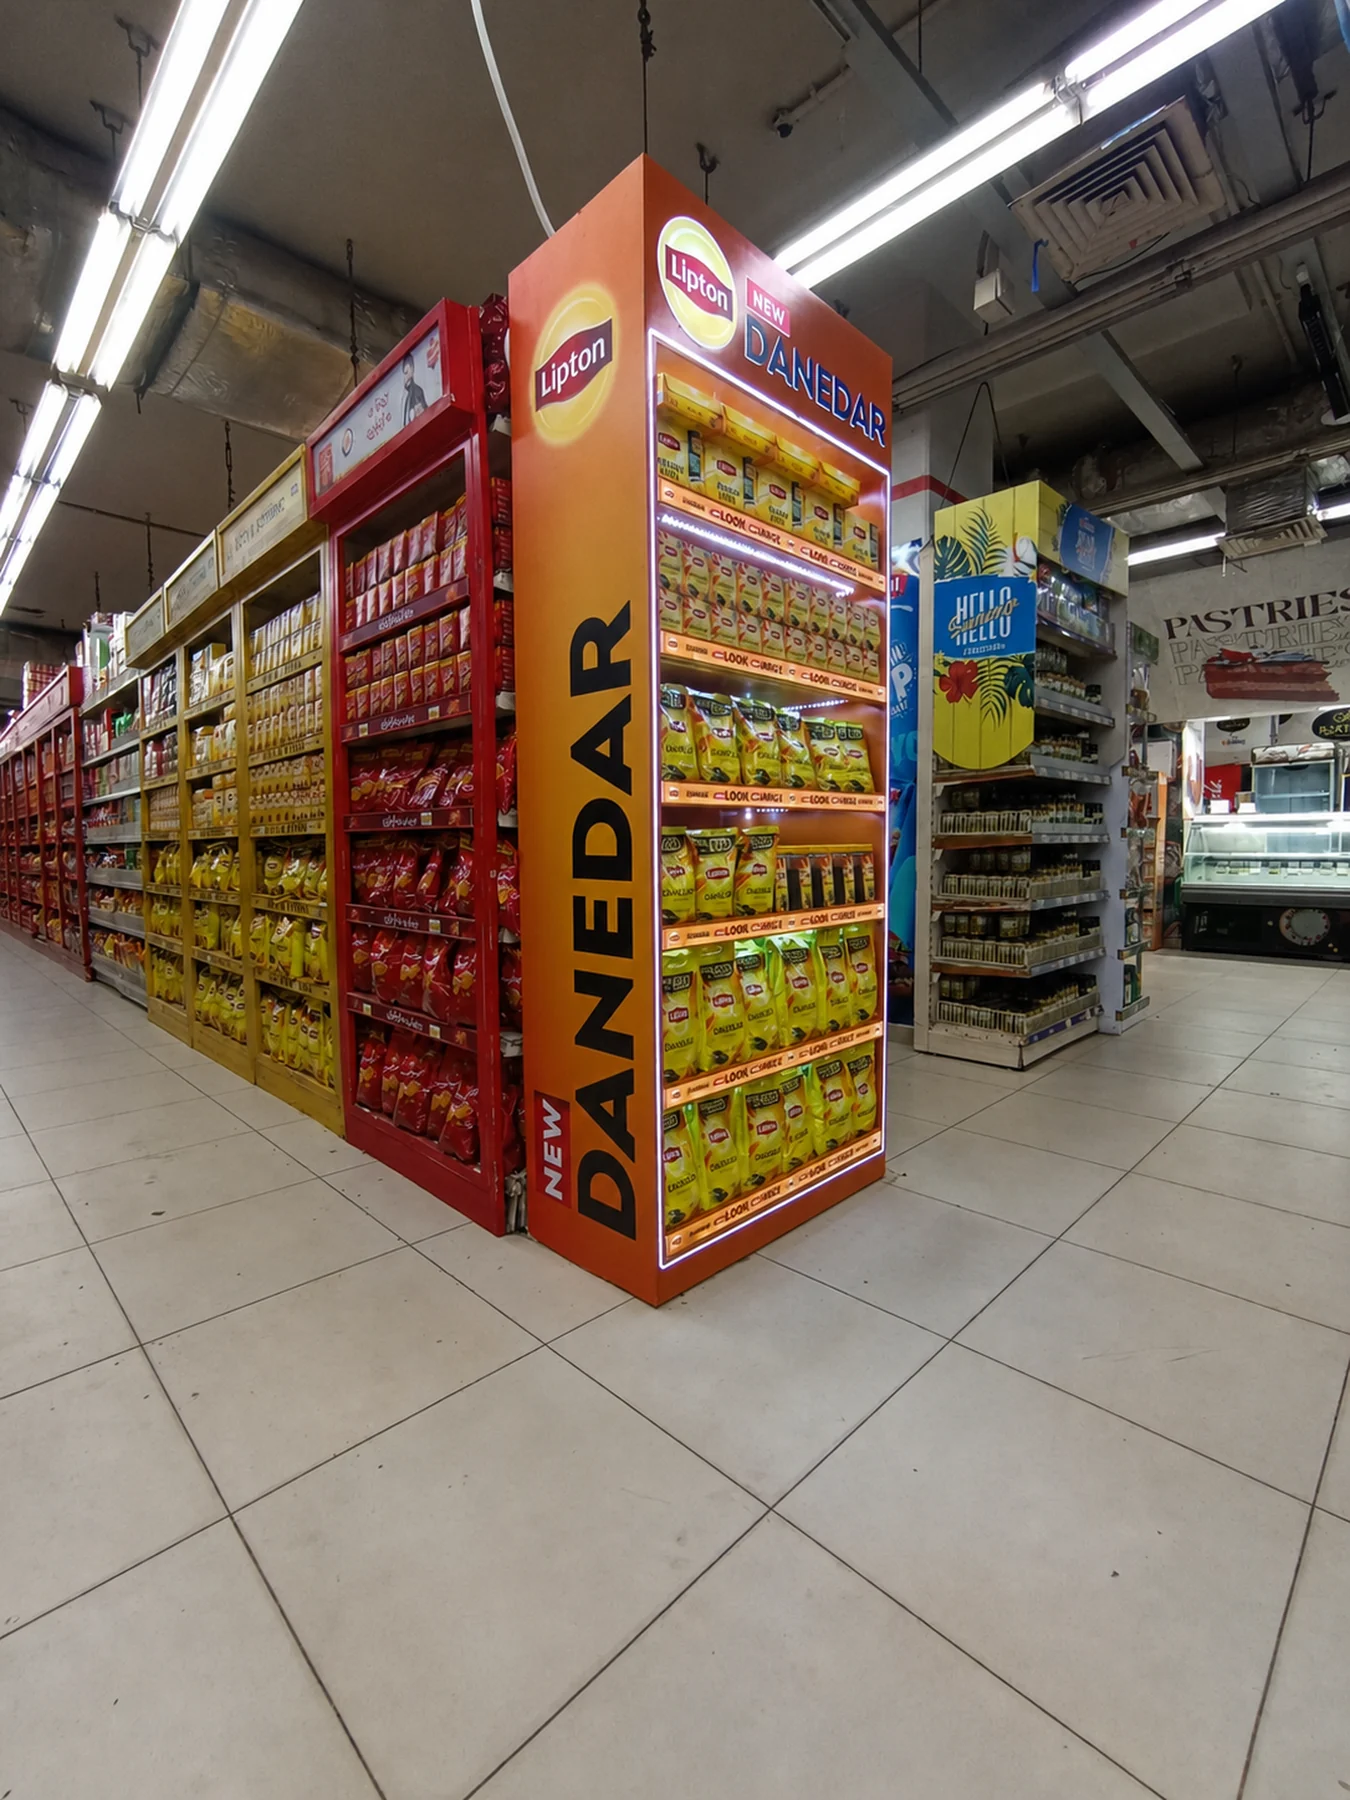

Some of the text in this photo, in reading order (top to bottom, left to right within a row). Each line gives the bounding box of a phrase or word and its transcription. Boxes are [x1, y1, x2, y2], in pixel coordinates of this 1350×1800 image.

[671, 253, 728, 311] Lipton
[752, 289, 786, 326] NEW
[541, 337, 605, 397] Lipton
[744, 313, 886, 448] DANEDAR
[570, 600, 637, 1241] DANEDAR
[542, 1098, 563, 1201] NEW
